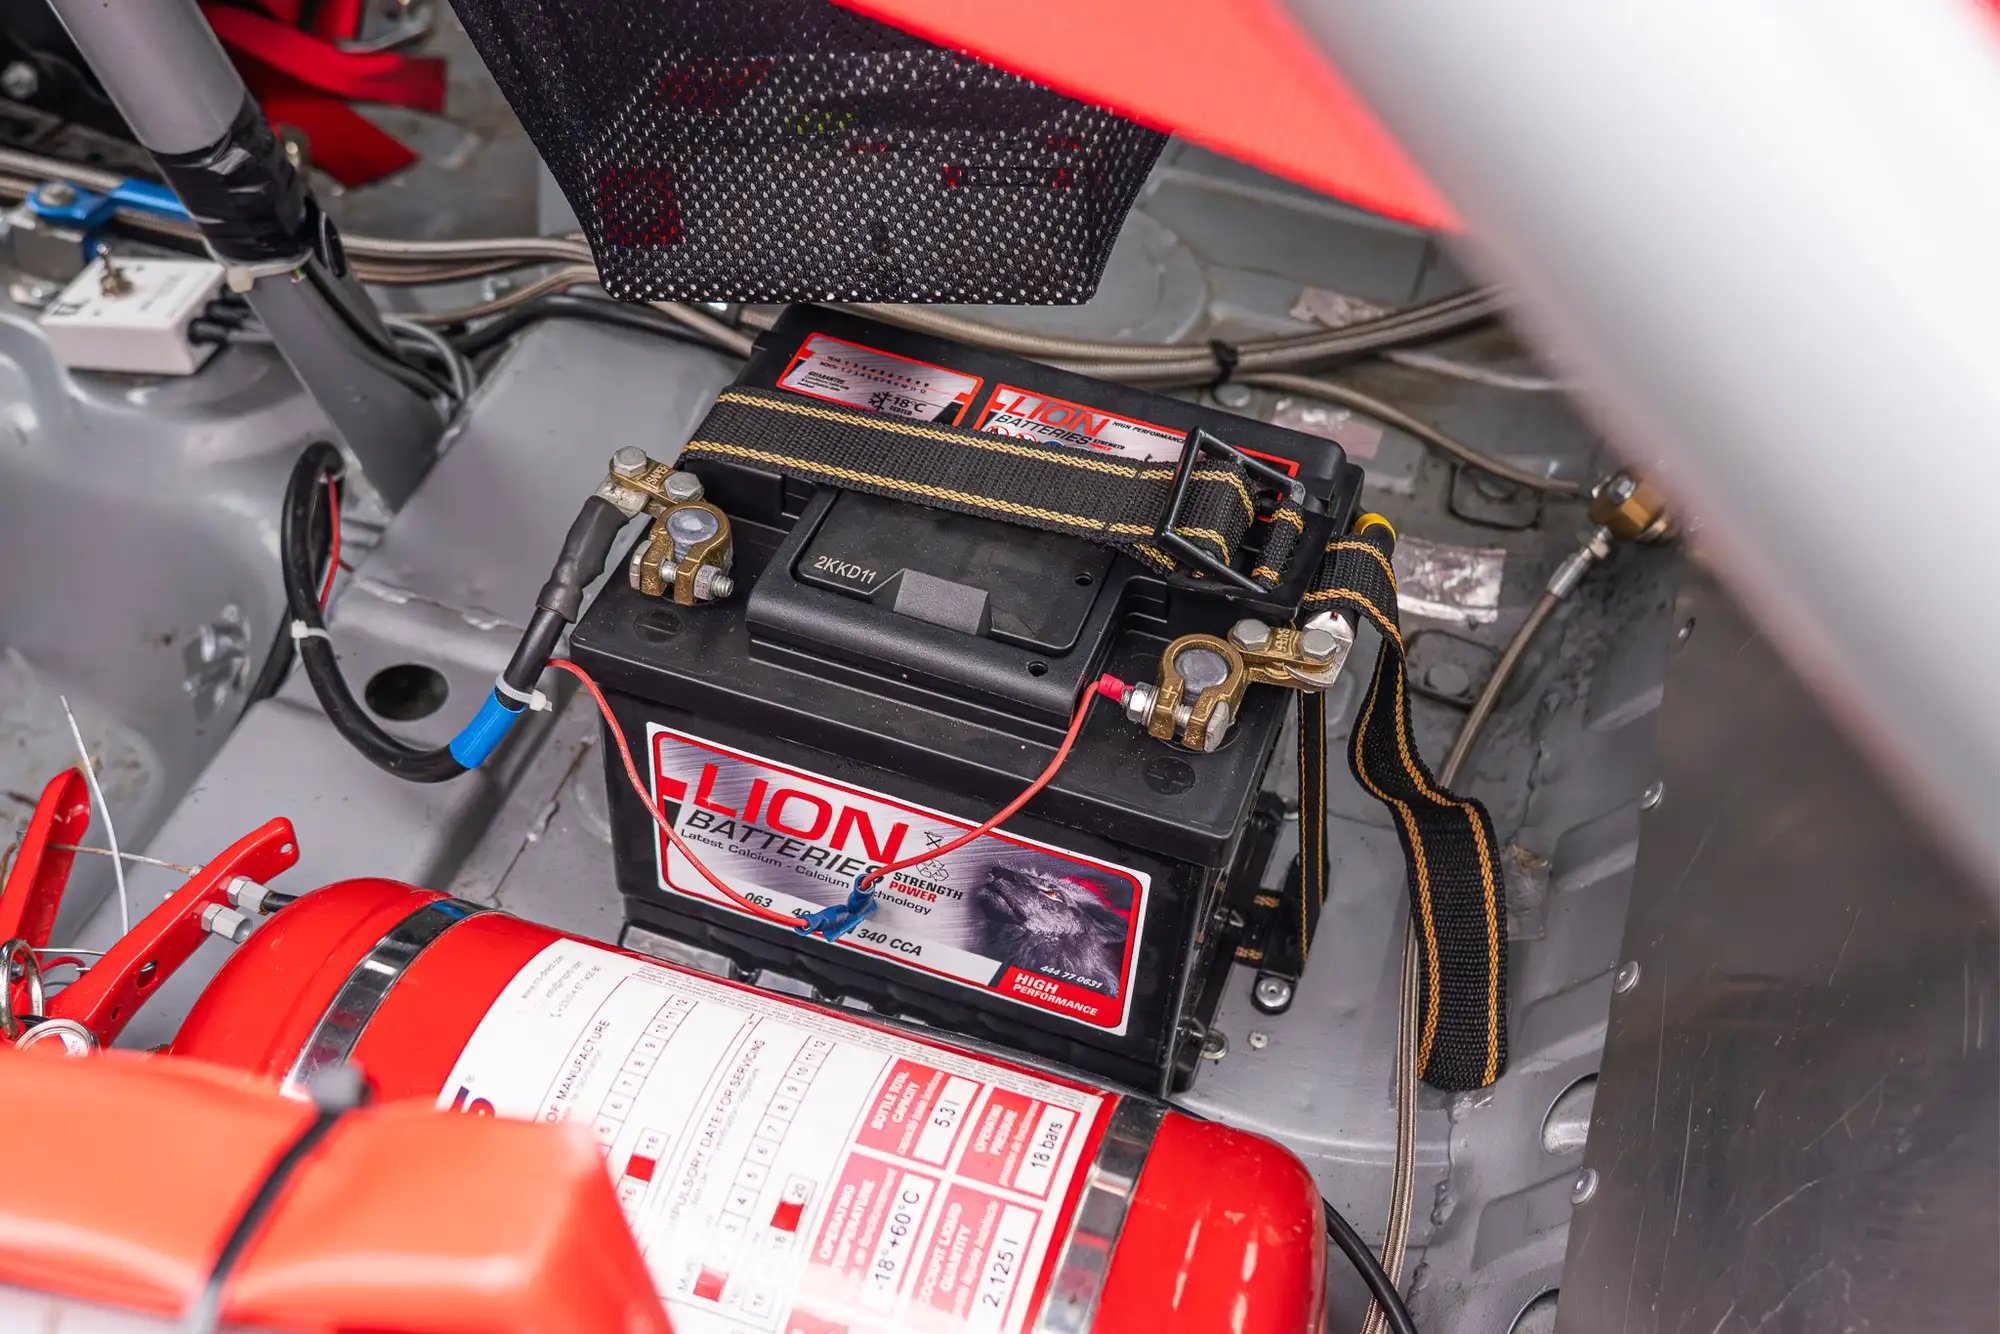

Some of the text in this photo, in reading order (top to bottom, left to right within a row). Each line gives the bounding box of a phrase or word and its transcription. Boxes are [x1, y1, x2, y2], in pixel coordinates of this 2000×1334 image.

[995, 413, 1094, 446] BATTERIES
[1004, 395, 1111, 438] LION
[1112, 420, 1131, 431] HIGH
[813, 555, 878, 586] 2KKD11
[693, 762, 910, 866] LION
[680, 828, 724, 850] Latest
[728, 843, 784, 868] Calcium
[795, 864, 851, 890] Calcium
[888, 880, 938, 904] POWER
[892, 871, 964, 901] STRENGTH
[744, 892, 774, 908] 063
[856, 928, 889, 944] 340
[889, 938, 923, 957] CCA
[1014, 973, 1059, 996] HIGH
[1039, 965, 1103, 989] 444 77 0631
[1012, 983, 1099, 1017] PERFORMANCE
[545, 1102, 561, 1124] OF
[555, 1018, 611, 1101] MANUFACTURE
[699, 1112, 723, 1149] DATE
[716, 1087, 734, 1113] FOR
[729, 1039, 766, 1089] SERVICING
[871, 1071, 911, 1131] BOTTLE TOTAL
[891, 1080, 921, 1123] CAPACITY
[973, 1103, 1004, 1153] OPERATING
[1030, 1121, 1064, 1168] 18 bars
[818, 1183, 856, 1260] OPERATING
[938, 1202, 963, 1247] LIQUID
[938, 1223, 973, 1292] QUANTITY
